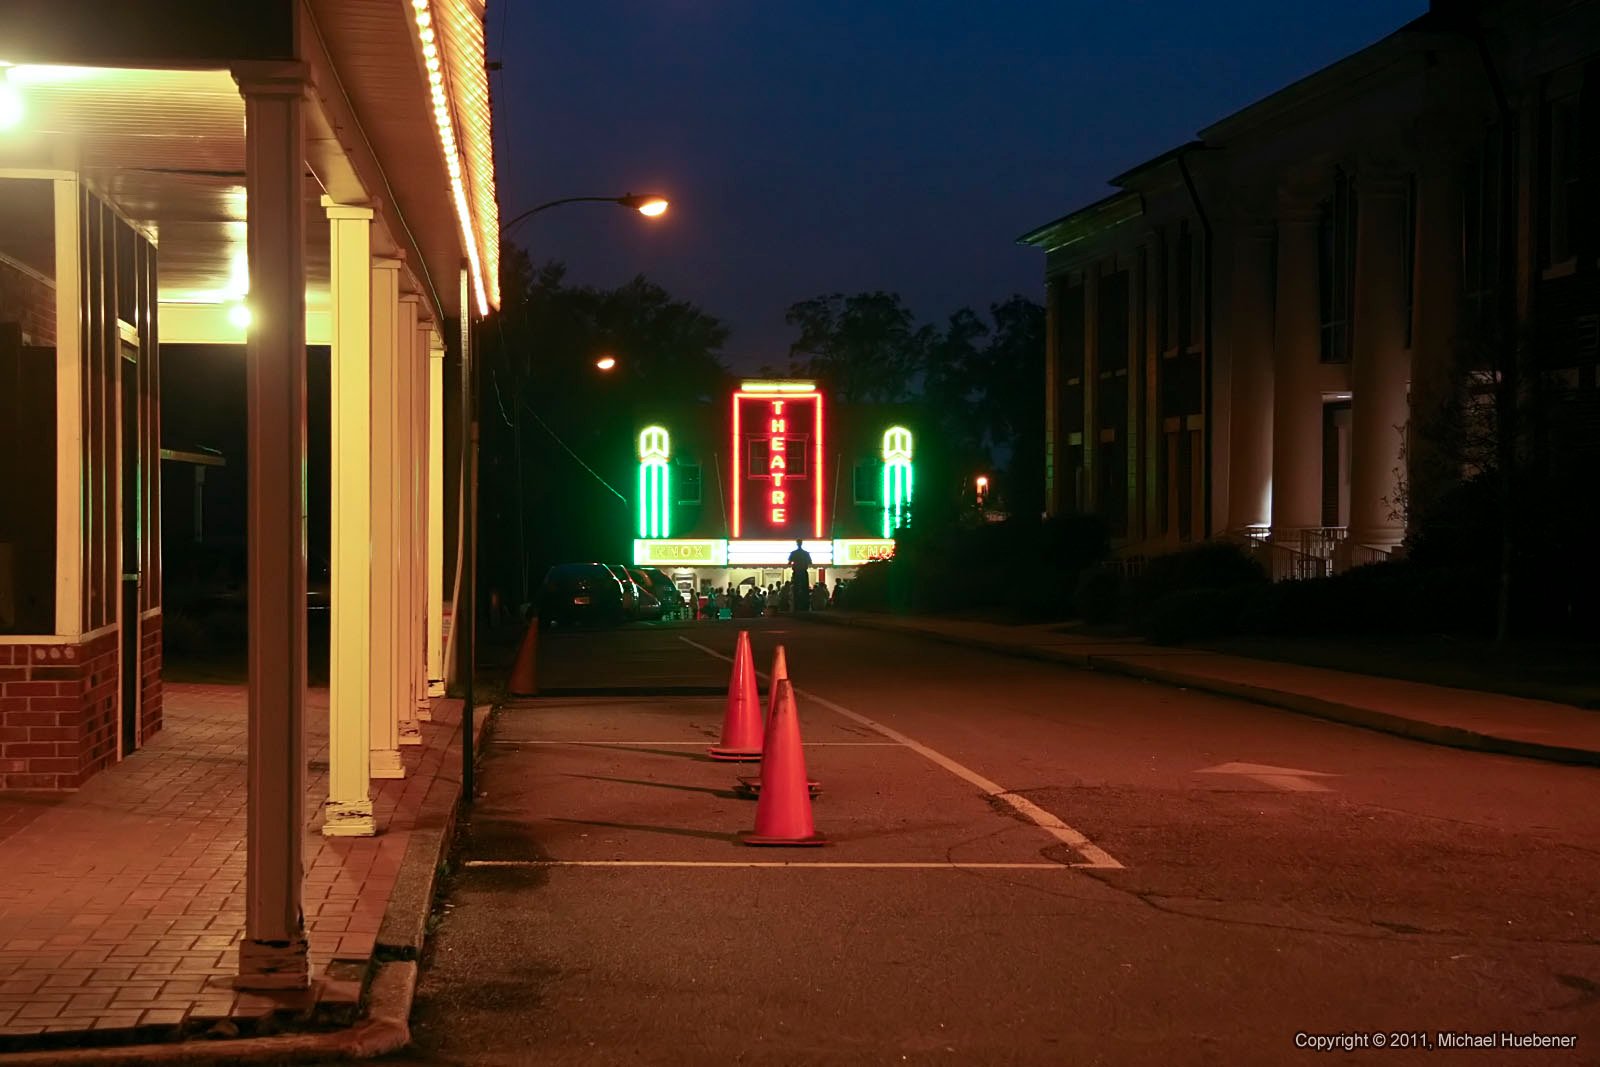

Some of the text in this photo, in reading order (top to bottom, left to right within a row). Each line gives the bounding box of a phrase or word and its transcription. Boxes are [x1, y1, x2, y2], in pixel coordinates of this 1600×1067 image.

[769, 400, 787, 524] THEATRE
[655, 544, 704, 559] KNOX
[855, 543, 894, 560] KNO
